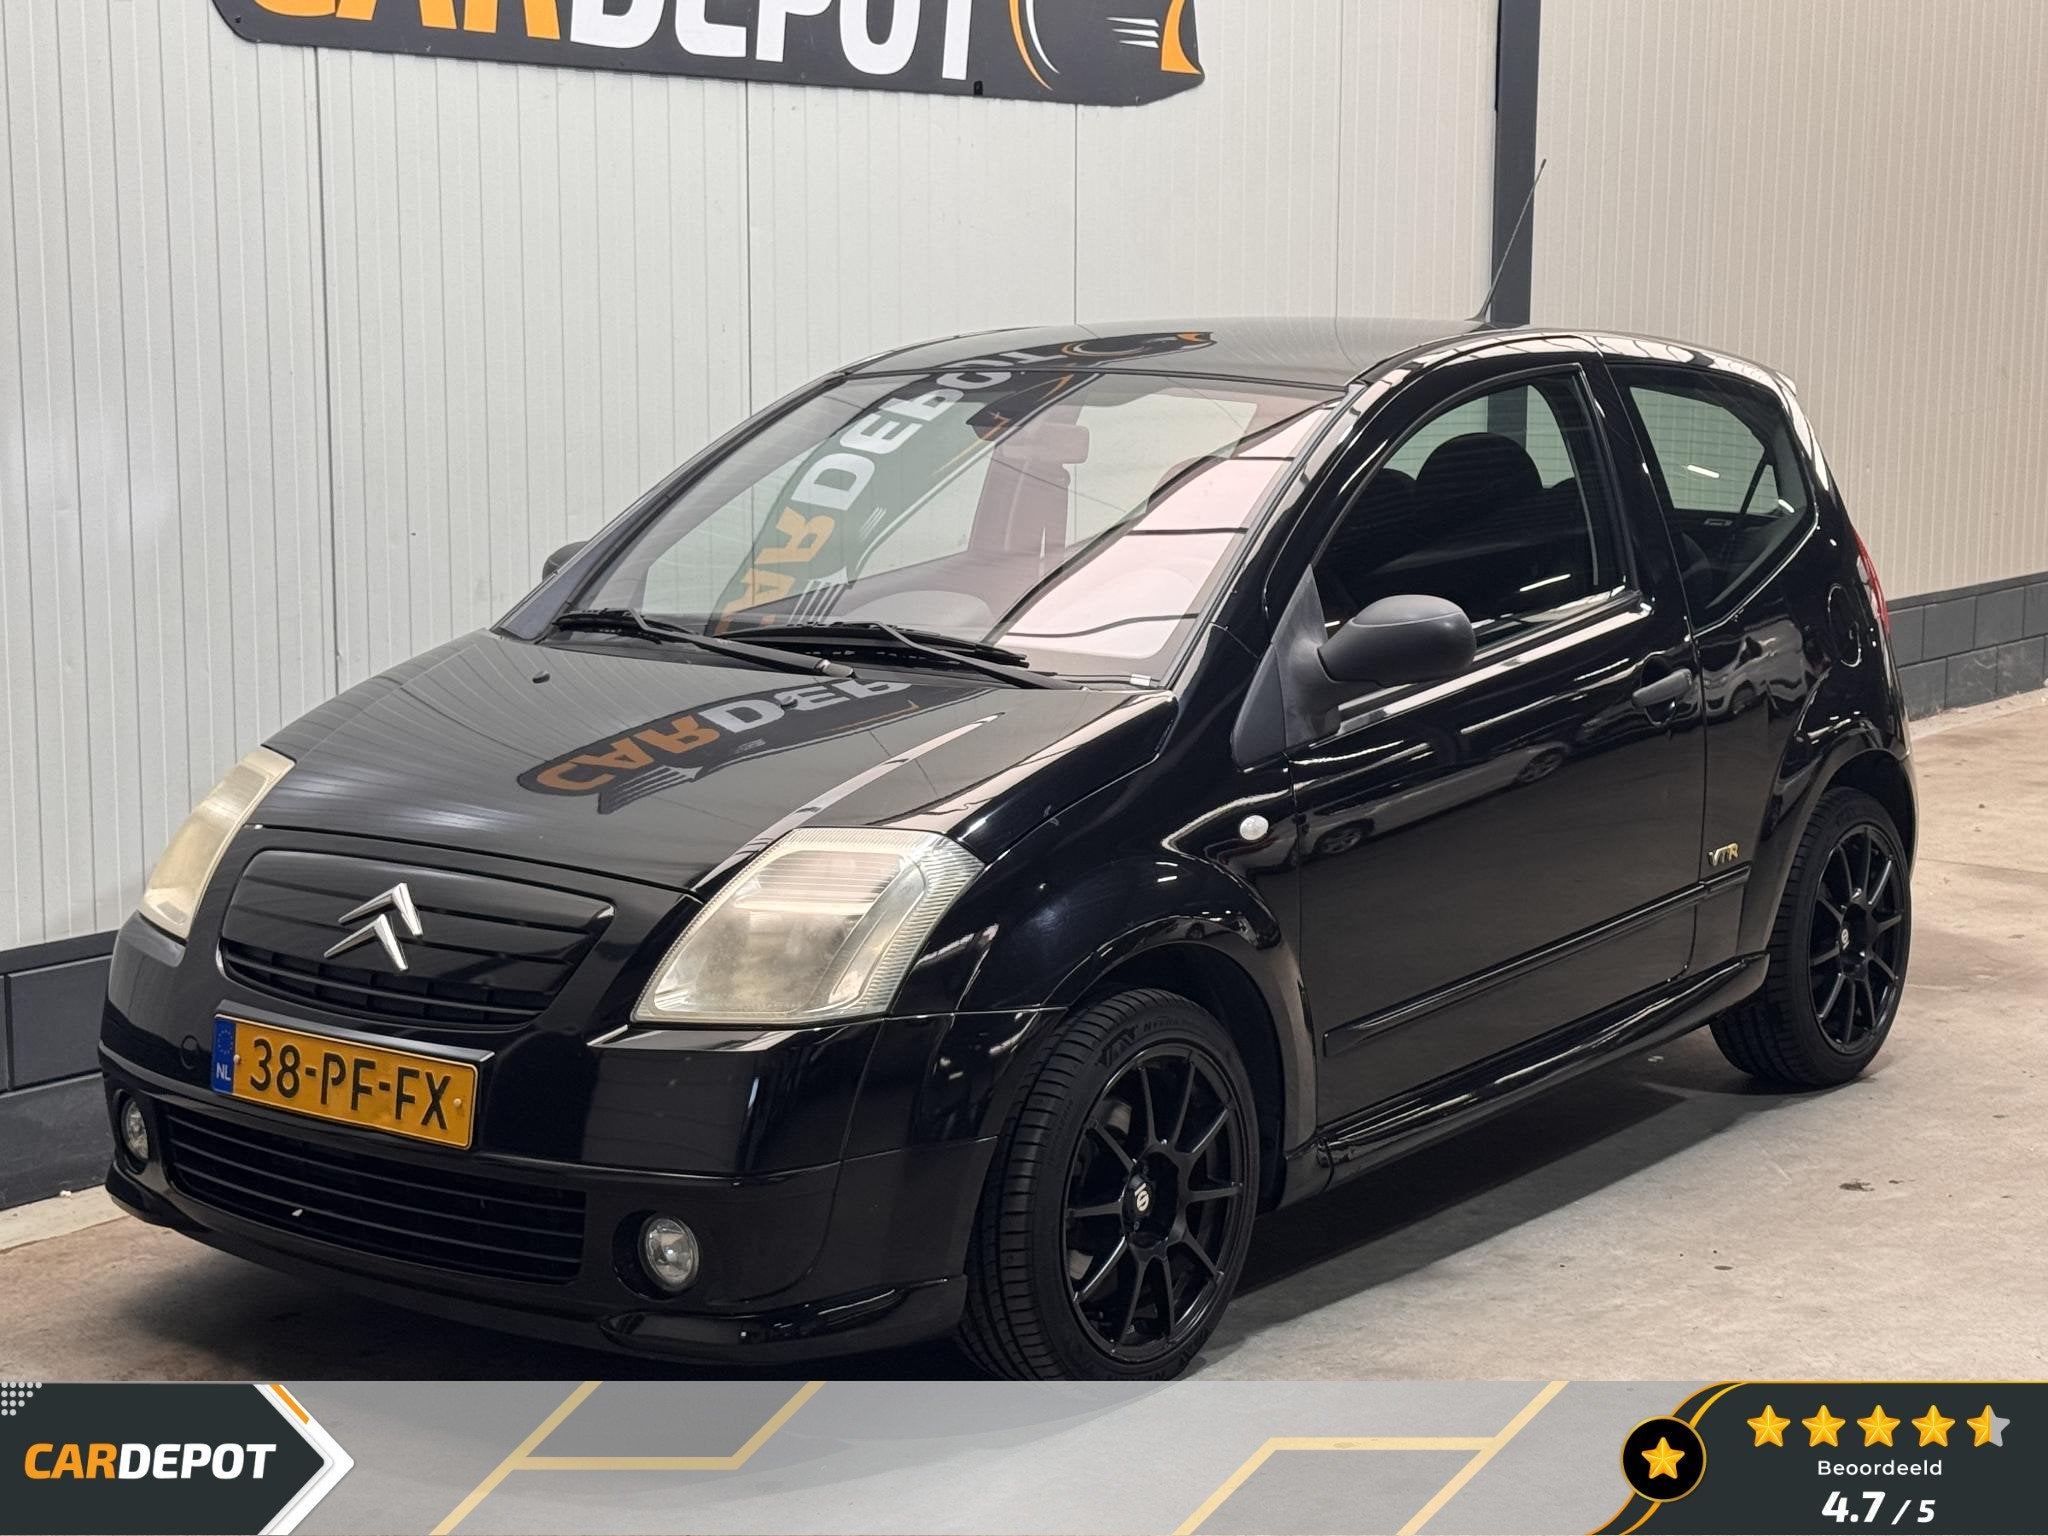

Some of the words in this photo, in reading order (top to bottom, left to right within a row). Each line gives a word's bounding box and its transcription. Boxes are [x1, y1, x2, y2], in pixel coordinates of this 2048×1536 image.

[1708, 843, 1739, 866] VTR
[216, 1063, 231, 1081] NL
[250, 1038, 452, 1130] 38-PF-FX
